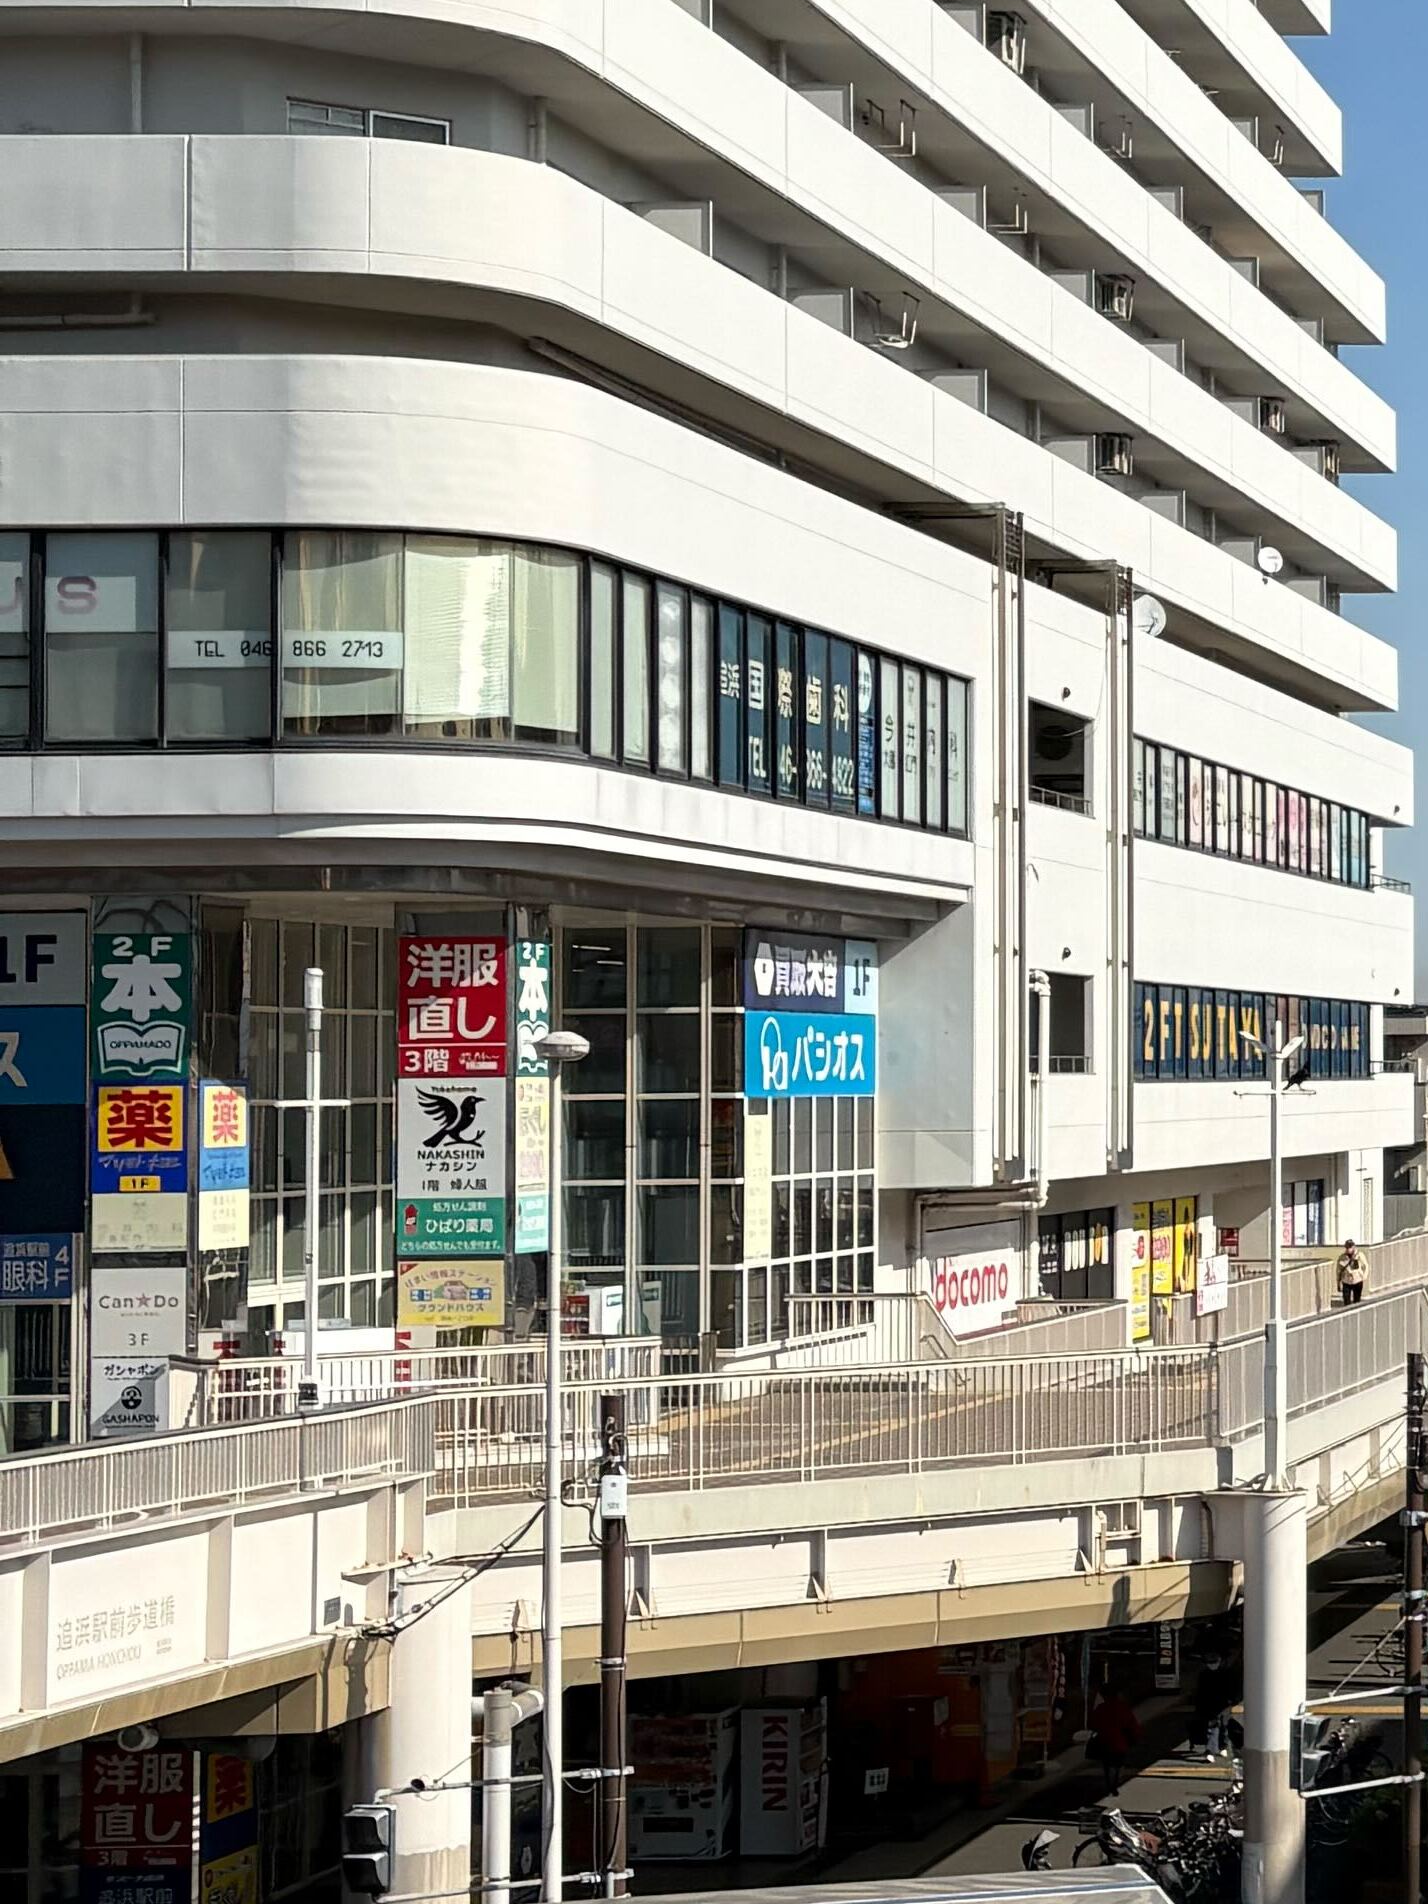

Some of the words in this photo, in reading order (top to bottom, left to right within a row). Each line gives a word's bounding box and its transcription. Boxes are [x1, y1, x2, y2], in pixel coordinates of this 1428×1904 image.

[195, 640, 225, 658] TEL
[240, 640, 275, 657] 046
[293, 640, 326, 656] 866
[342, 639, 384, 658] 2713
[112, 936, 173, 957] 2F
[407, 943, 499, 988] 洋服
[522, 942, 545, 961] 2F
[101, 954, 182, 1023] 本
[518, 957, 548, 1022] 本
[774, 945, 838, 998] 買取大吉
[853, 958, 870, 997] 1F
[407, 995, 497, 1041] 直し
[1174, 1002, 1264, 1062] TSUTAYA
[404, 1049, 449, 1073] 3階
[791, 1025, 866, 1082] パシオス
[107, 1090, 174, 1148] 薬
[212, 1090, 240, 1144] 薬
[417, 1150, 485, 1160] NAKASHIN
[425, 1162, 478, 1173] ナカシン
[450, 1179, 488, 1192] 婦人服
[425, 1218, 495, 1234] ひばり薬局
[2, 1260, 49, 1293] 眼科
[934, 1251, 1008, 1313] docomo
[127, 1333, 150, 1346] 3F
[102, 1414, 160, 1426] GASHAPON
[56, 1594, 175, 1652] 追浜駅前歩道橋
[94, 1752, 186, 1796] 洋服
[763, 1715, 791, 1811] KIRIN
[94, 1802, 183, 1844] 直し
